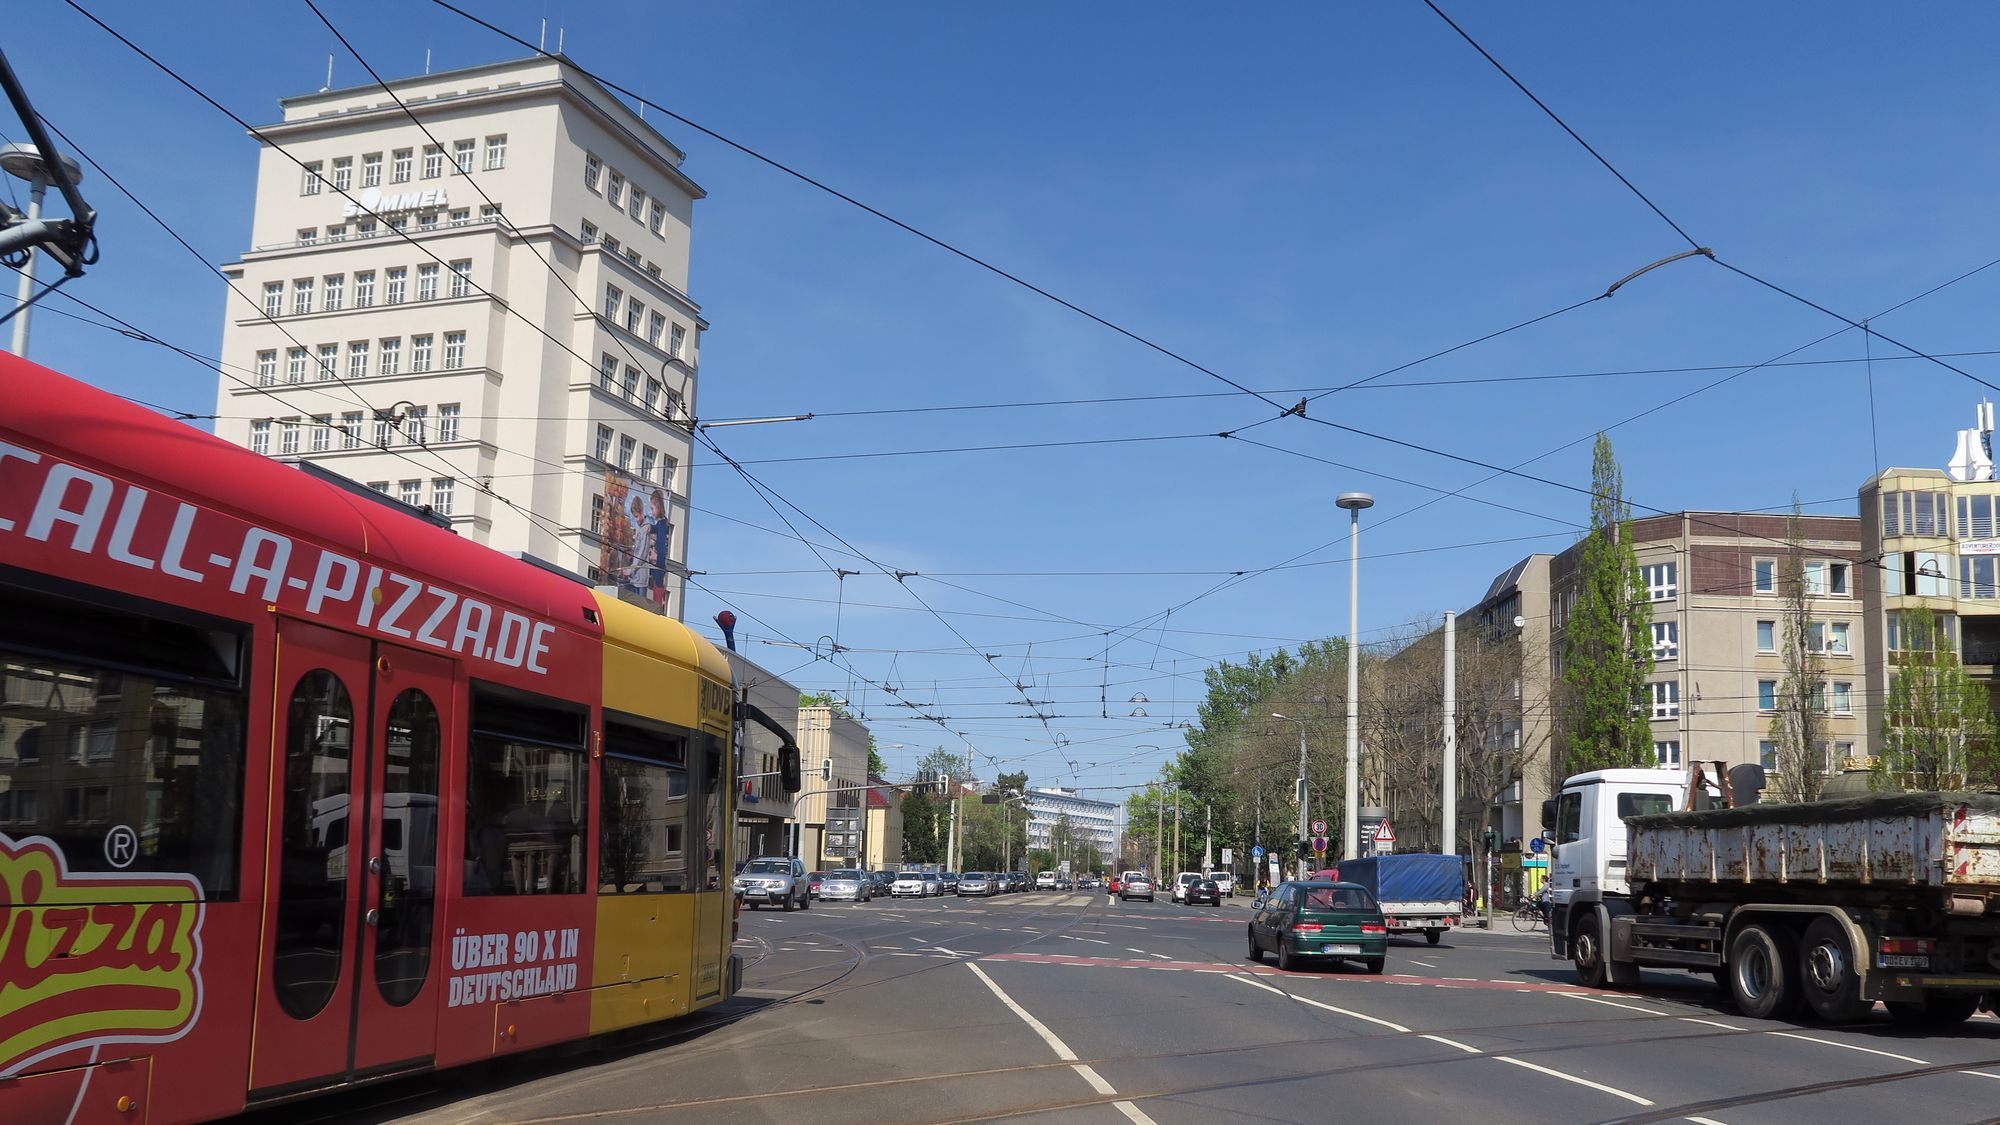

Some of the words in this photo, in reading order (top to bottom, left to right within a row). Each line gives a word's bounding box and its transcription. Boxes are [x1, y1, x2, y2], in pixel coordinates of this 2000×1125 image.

[342, 187, 448, 217] SMMEL
[1316, 823, 1324, 831] 30
[0, 869, 182, 990] izza
[451, 928, 509, 971] ÜBER
[514, 931, 539, 964] 90
[542, 930, 557, 961] X
[559, 928, 580, 959] IN
[448, 963, 578, 1008] DEUTSCHLAND
